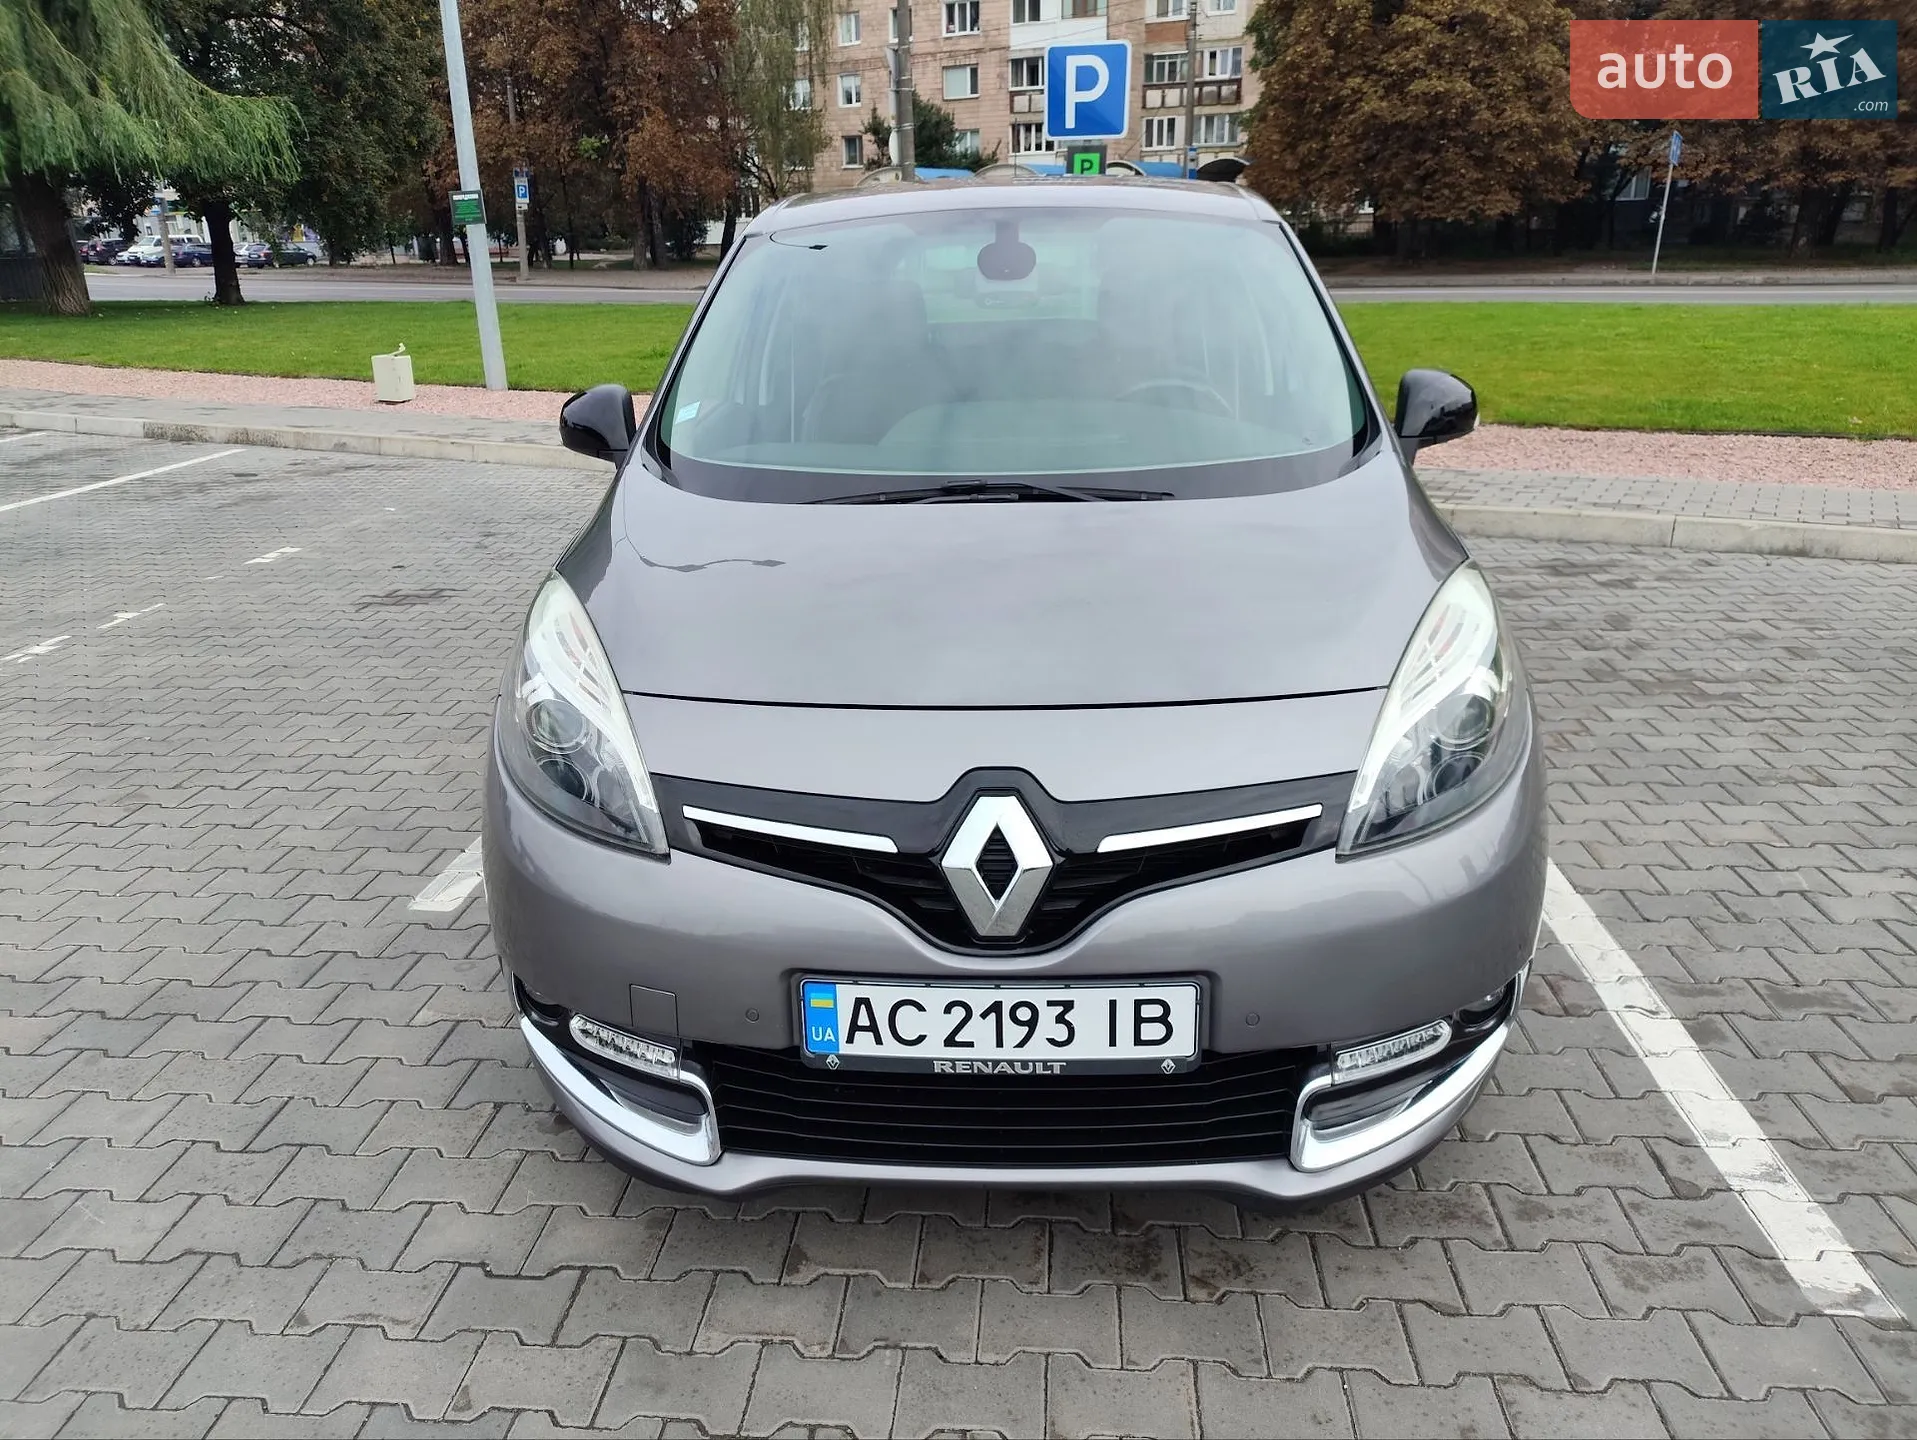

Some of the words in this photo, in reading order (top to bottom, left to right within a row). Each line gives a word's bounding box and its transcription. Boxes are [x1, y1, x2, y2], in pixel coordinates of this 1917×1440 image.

[1065, 54, 1109, 129] P
[1080, 159, 1093, 175] P
[518, 186, 526, 196] P
[845, 997, 928, 1047] AC
[943, 1000, 1076, 1049] 2193
[1109, 998, 1175, 1048] IB
[811, 1026, 836, 1043] UA
[932, 1060, 1067, 1076] RENAULT
